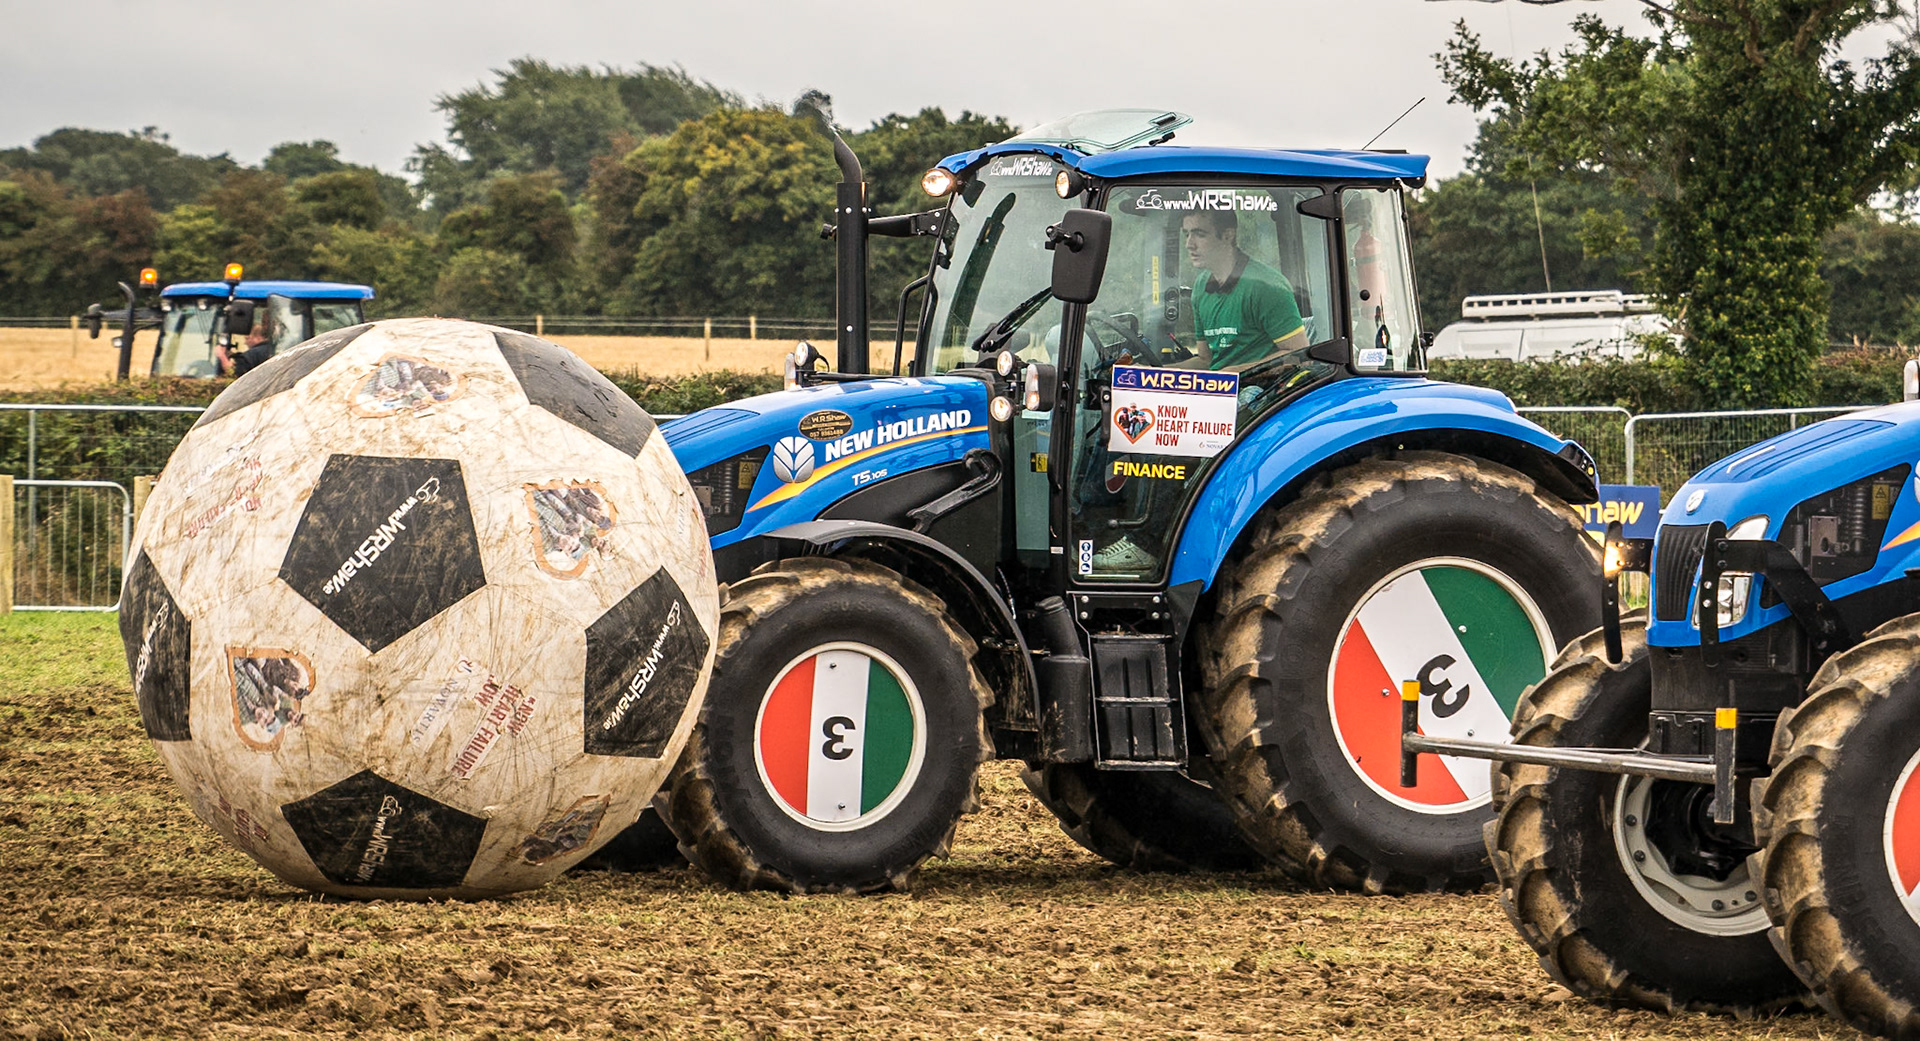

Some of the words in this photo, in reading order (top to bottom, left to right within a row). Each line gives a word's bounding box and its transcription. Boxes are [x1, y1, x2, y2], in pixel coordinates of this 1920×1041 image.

[1163, 190, 1278, 212] www.WRShaw.ie
[1140, 371, 1235, 393] W.R.Shaw
[1157, 405, 1188, 419] KNOW
[825, 428, 874, 462] NEW
[877, 409, 971, 445] HOLLAND
[1156, 419, 1189, 433] HEART
[1192, 421, 1232, 436] FAILURE
[1155, 433, 1180, 447] NOW
[1112, 461, 1186, 480] FINANCE
[322, 496, 418, 595] www.WRShaw.ie
[603, 624, 670, 730] www.WRShaw.ie
[822, 715, 856, 760] 3
[451, 727, 495, 777] FAILURE
